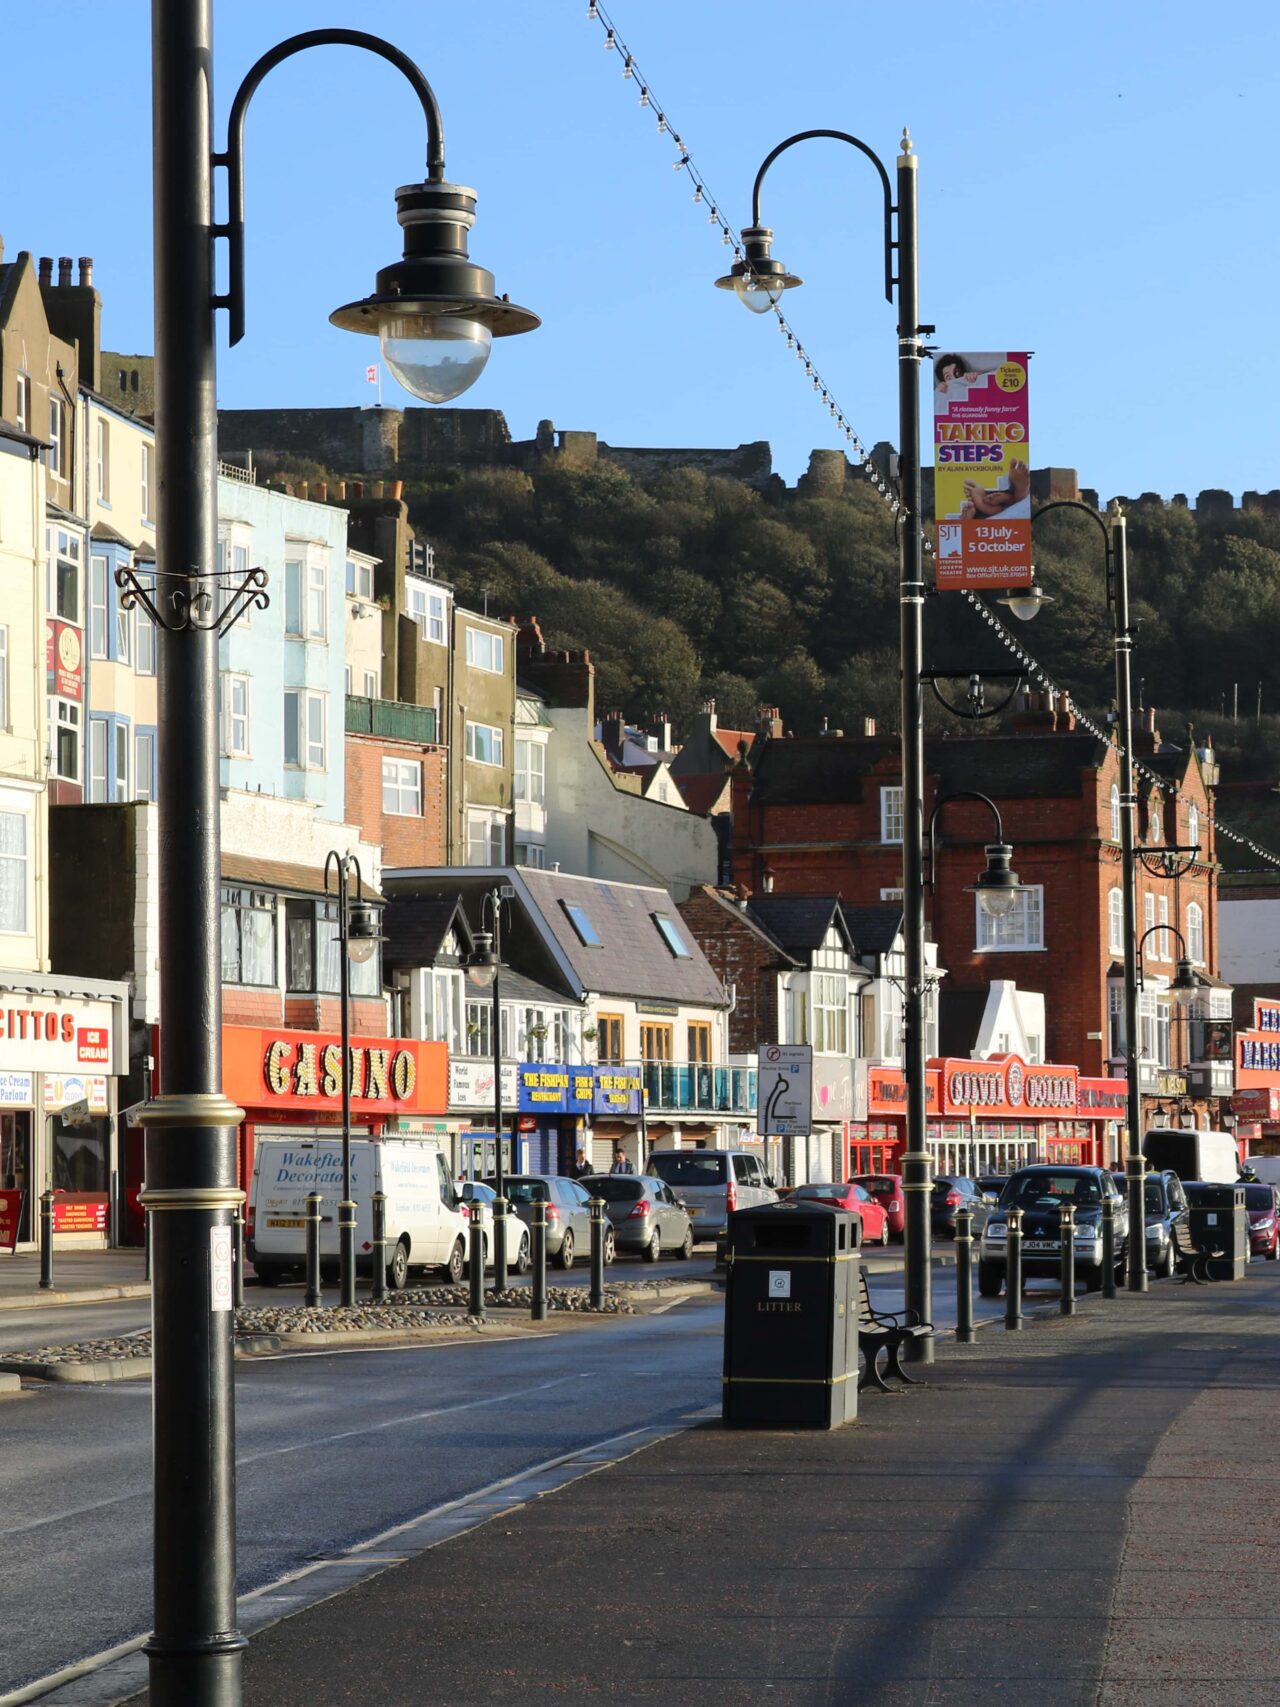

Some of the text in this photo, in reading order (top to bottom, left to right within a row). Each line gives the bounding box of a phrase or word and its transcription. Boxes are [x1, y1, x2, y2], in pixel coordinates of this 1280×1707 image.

[1002, 378, 1020, 388] £10
[958, 406, 984, 414] riotously
[984, 406, 1001, 414] funny
[937, 422, 1025, 443] TAKING
[938, 443, 1005, 463] STEPS
[939, 525, 960, 541] SJT
[976, 527, 989, 538] 13
[989, 526, 1012, 540] July
[968, 541, 1025, 553] 5 October
[966, 564, 1028, 575] www.sjt.uk.com
[87, 1031, 100, 1044] ICE
[79, 1046, 108, 1059] CREAM
[264, 1040, 416, 1101] CASINO
[455, 1066, 468, 1075] World
[8, 1075, 30, 1088] Cream
[453, 1079, 470, 1089] Famous
[523, 1073, 569, 1088] THE FISHPAN
[575, 1077, 588, 1088] FISH
[600, 1076, 614, 1089] THE
[1, 1089, 28, 1101] Parlour
[575, 1088, 593, 1099] CHIPS
[950, 1073, 1004, 1105] SILVER
[1025, 1075, 1076, 1107] DOLLAR
[282, 1152, 356, 1168] Wakefied
[276, 1168, 358, 1184] Decoratos
[757, 1302, 803, 1312] LITTER
